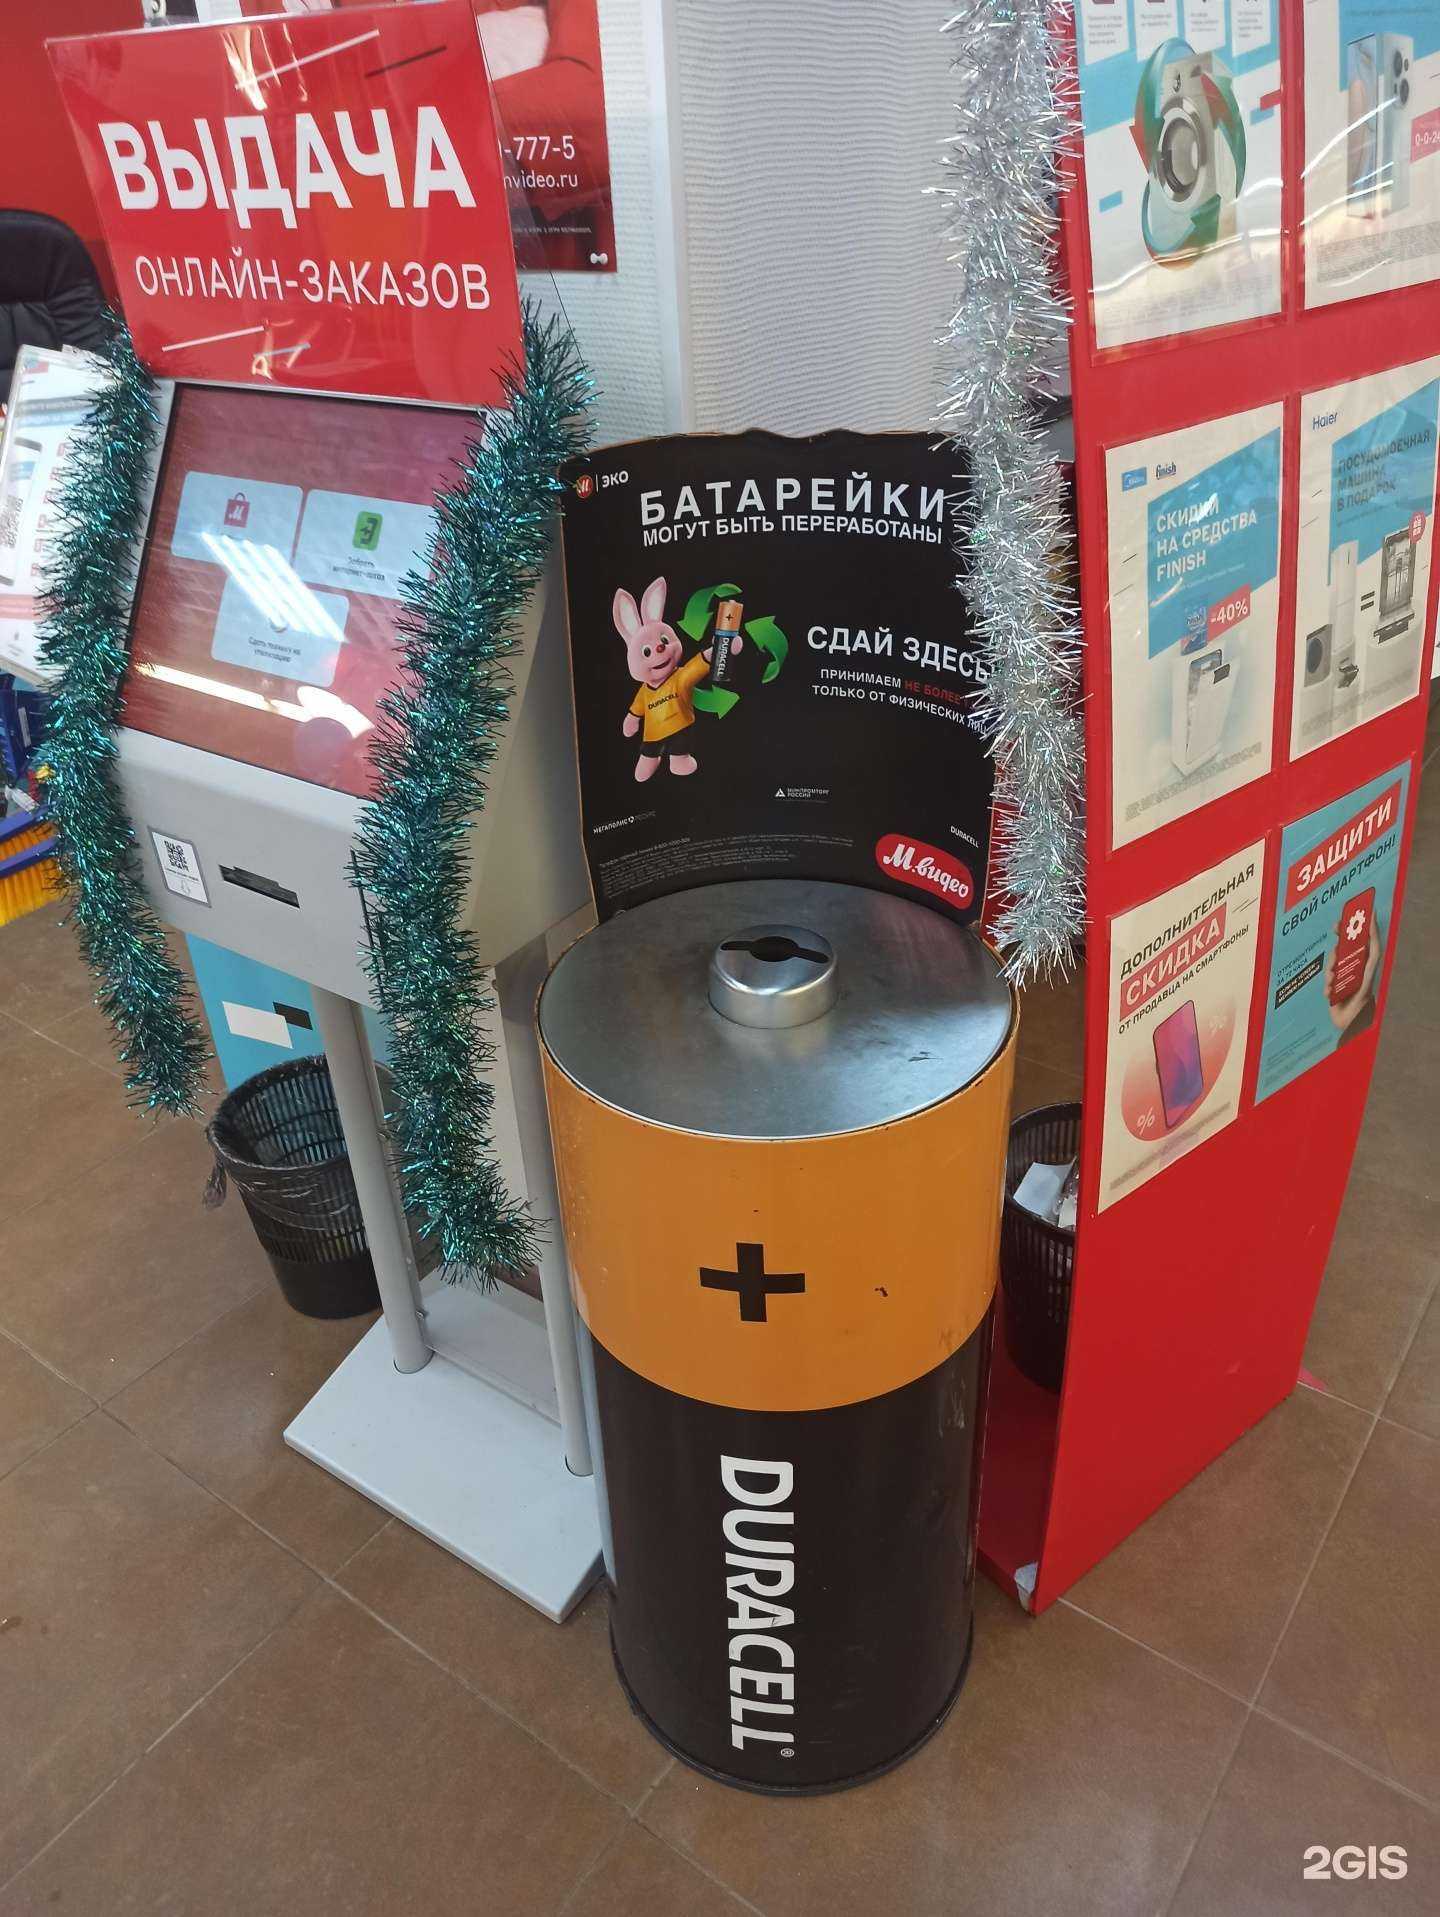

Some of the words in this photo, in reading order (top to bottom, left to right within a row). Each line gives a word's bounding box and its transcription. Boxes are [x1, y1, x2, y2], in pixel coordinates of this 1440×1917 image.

[99, 106, 476, 229] ВЫДАЧА
[498, 135, 575, 161] -777-5
[135, 247, 490, 309] ОНЛАЙН-ЗАКАЗОВ
[1312, 412, 1338, 430] Haier
[1156, 462, 1176, 480] finish
[1338, 429, 1430, 473] ПОСУДОМОЕЧНАЯ
[602, 470, 629, 488] ЭКО
[641, 471, 944, 526] БАТАРЕЙКИ
[643, 520, 711, 547] МОГУТ
[716, 516, 775, 536] БЫТЬ
[782, 515, 942, 544] ПЕРЕРАБОТАНЫ
[1157, 536, 1178, 558] НА
[1182, 509, 1257, 548] СРЕДСТВА
[1156, 550, 1206, 582] FINISH
[1210, 598, 1248, 624] -40%
[717, 637, 730, 677] DURACELL
[807, 626, 893, 656] СДАЙ
[902, 637, 992, 683] ЗДЕСЬ
[648, 692, 679, 710] DURACELL
[812, 685, 866, 699] ТОЛЬКО
[869, 690, 886, 703] ОТ
[889, 694, 965, 725] ФИЗИЧЕСКИХ
[820, 669, 901, 688] ПРИНИМАЕМ
[904, 680, 921, 693] НЕ
[923, 684, 961, 705] БОЛЕЕ
[950, 825, 979, 848] DURACELL
[1296, 797, 1392, 892] ЗАЩИТИ
[1120, 863, 1255, 980] ДОПОЛНИТЕЛЬНАЯ
[1282, 895, 1319, 936] СВОЙ
[1119, 1020, 1132, 1035] ОТ
[1133, 981, 1181, 1024] ПРОДАВЦА
[1182, 970, 1195, 984] НА
[1195, 924, 1249, 973] СМАРТФОНЫ
[1126, 917, 1221, 1006] СКИДКА
[720, 1454, 795, 1750] DURACELL
